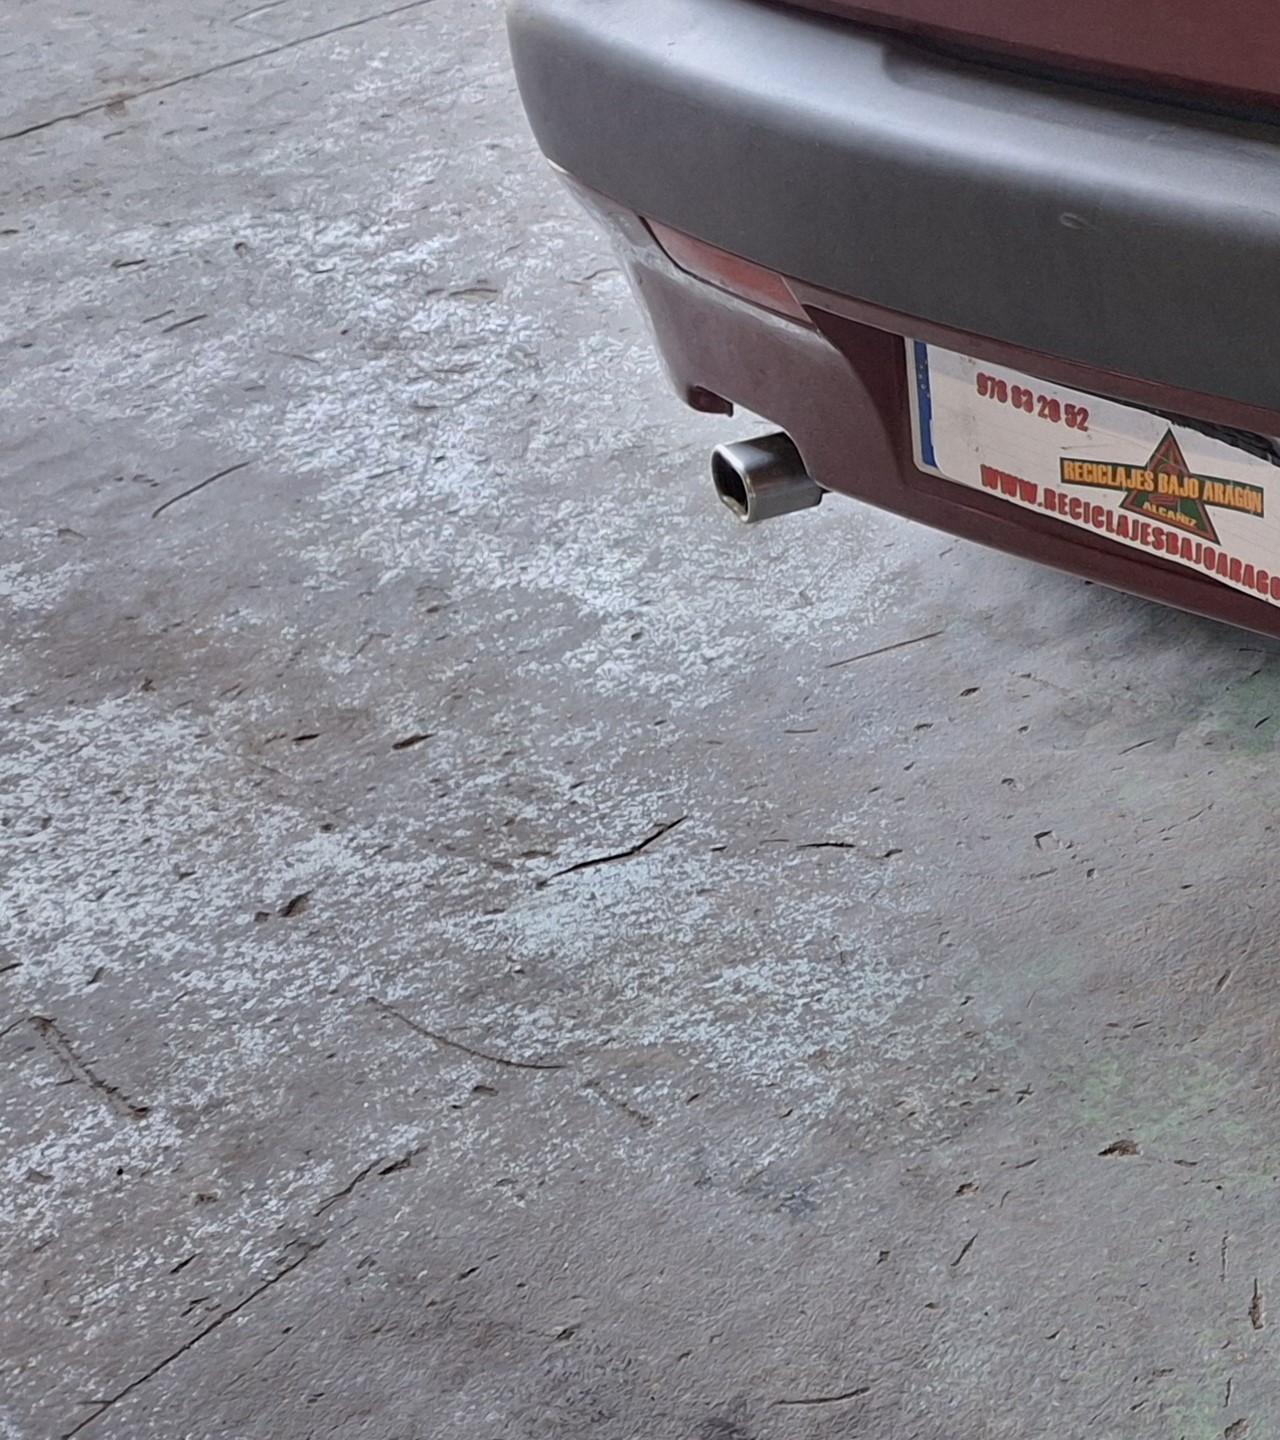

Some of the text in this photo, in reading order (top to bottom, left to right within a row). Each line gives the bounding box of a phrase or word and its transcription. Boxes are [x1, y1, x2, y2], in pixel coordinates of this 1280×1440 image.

[976, 371, 1089, 432] 978 83 20 52
[1062, 460, 1155, 493] RECICLAJES
[1157, 473, 1200, 499] BAJO
